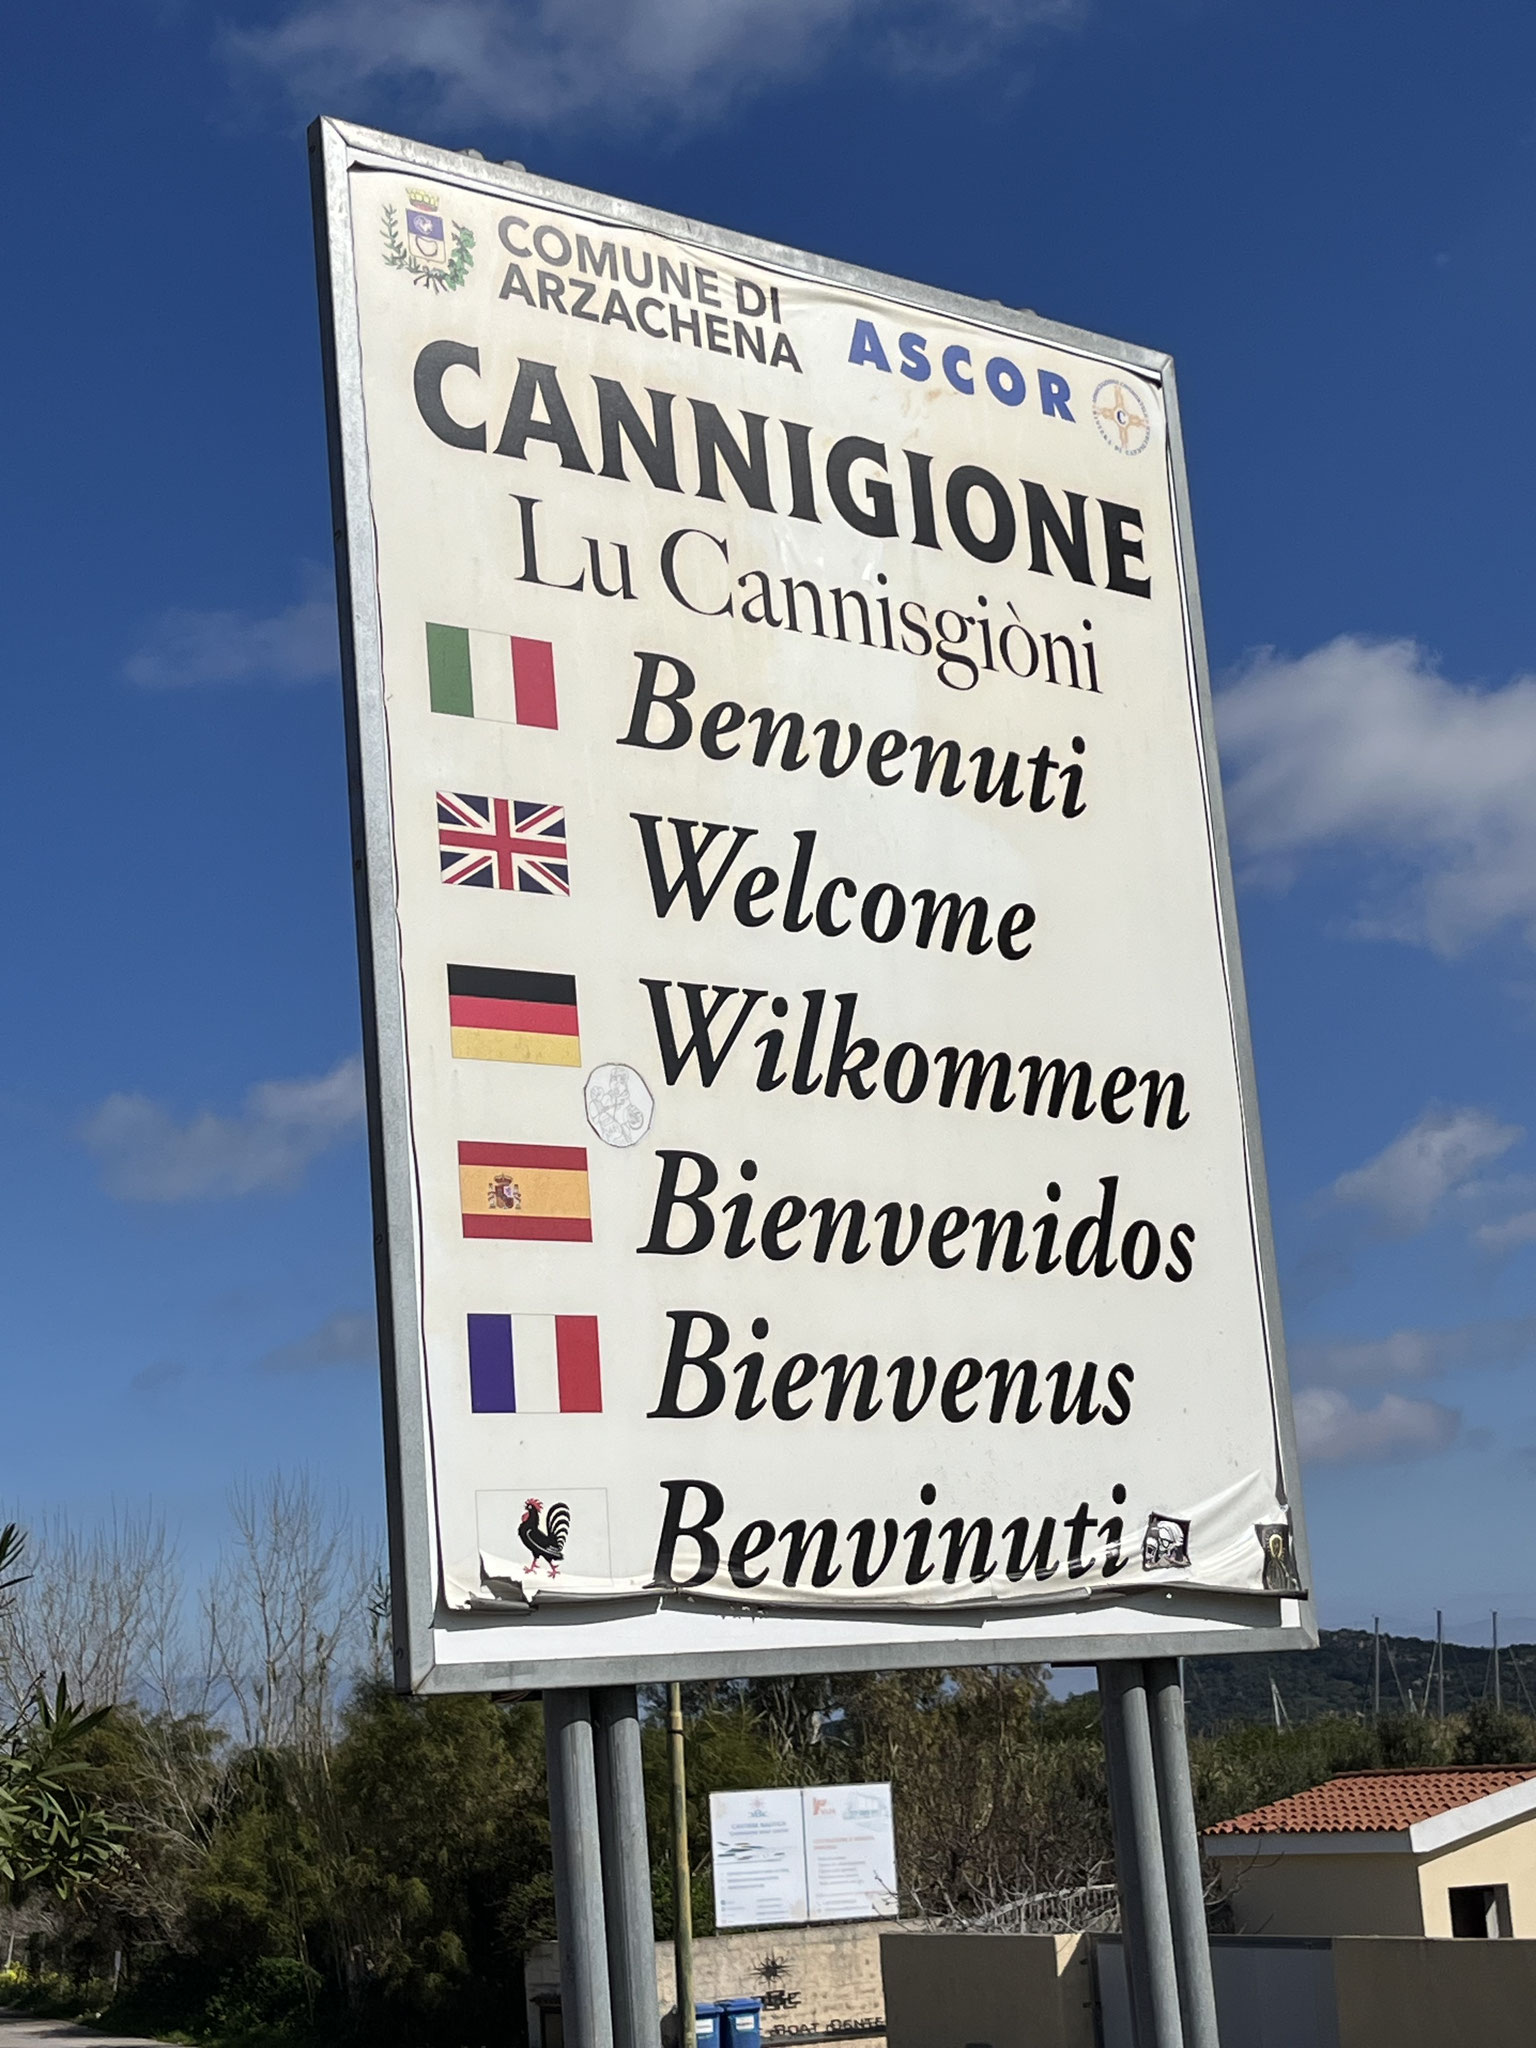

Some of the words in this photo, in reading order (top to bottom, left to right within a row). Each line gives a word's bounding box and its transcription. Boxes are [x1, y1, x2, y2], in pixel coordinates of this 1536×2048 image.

[497, 214, 726, 311] COMUNE
[735, 278, 783, 324] DI
[498, 262, 804, 375] ARZACHENA
[848, 317, 1077, 425] ASCOR
[412, 338, 1153, 600] CANNIGIONE
[508, 493, 640, 602] Lu
[660, 527, 1105, 694] Cannisgiòni
[616, 650, 1088, 819] Benvenuti
[629, 811, 1037, 961] Welcome
[638, 977, 1190, 1131] Wilkommen
[636, 1149, 1196, 1283] Bienvenidos
[646, 1309, 1135, 1426] Bienvenus
[641, 1479, 1134, 1590] Benvinuti
